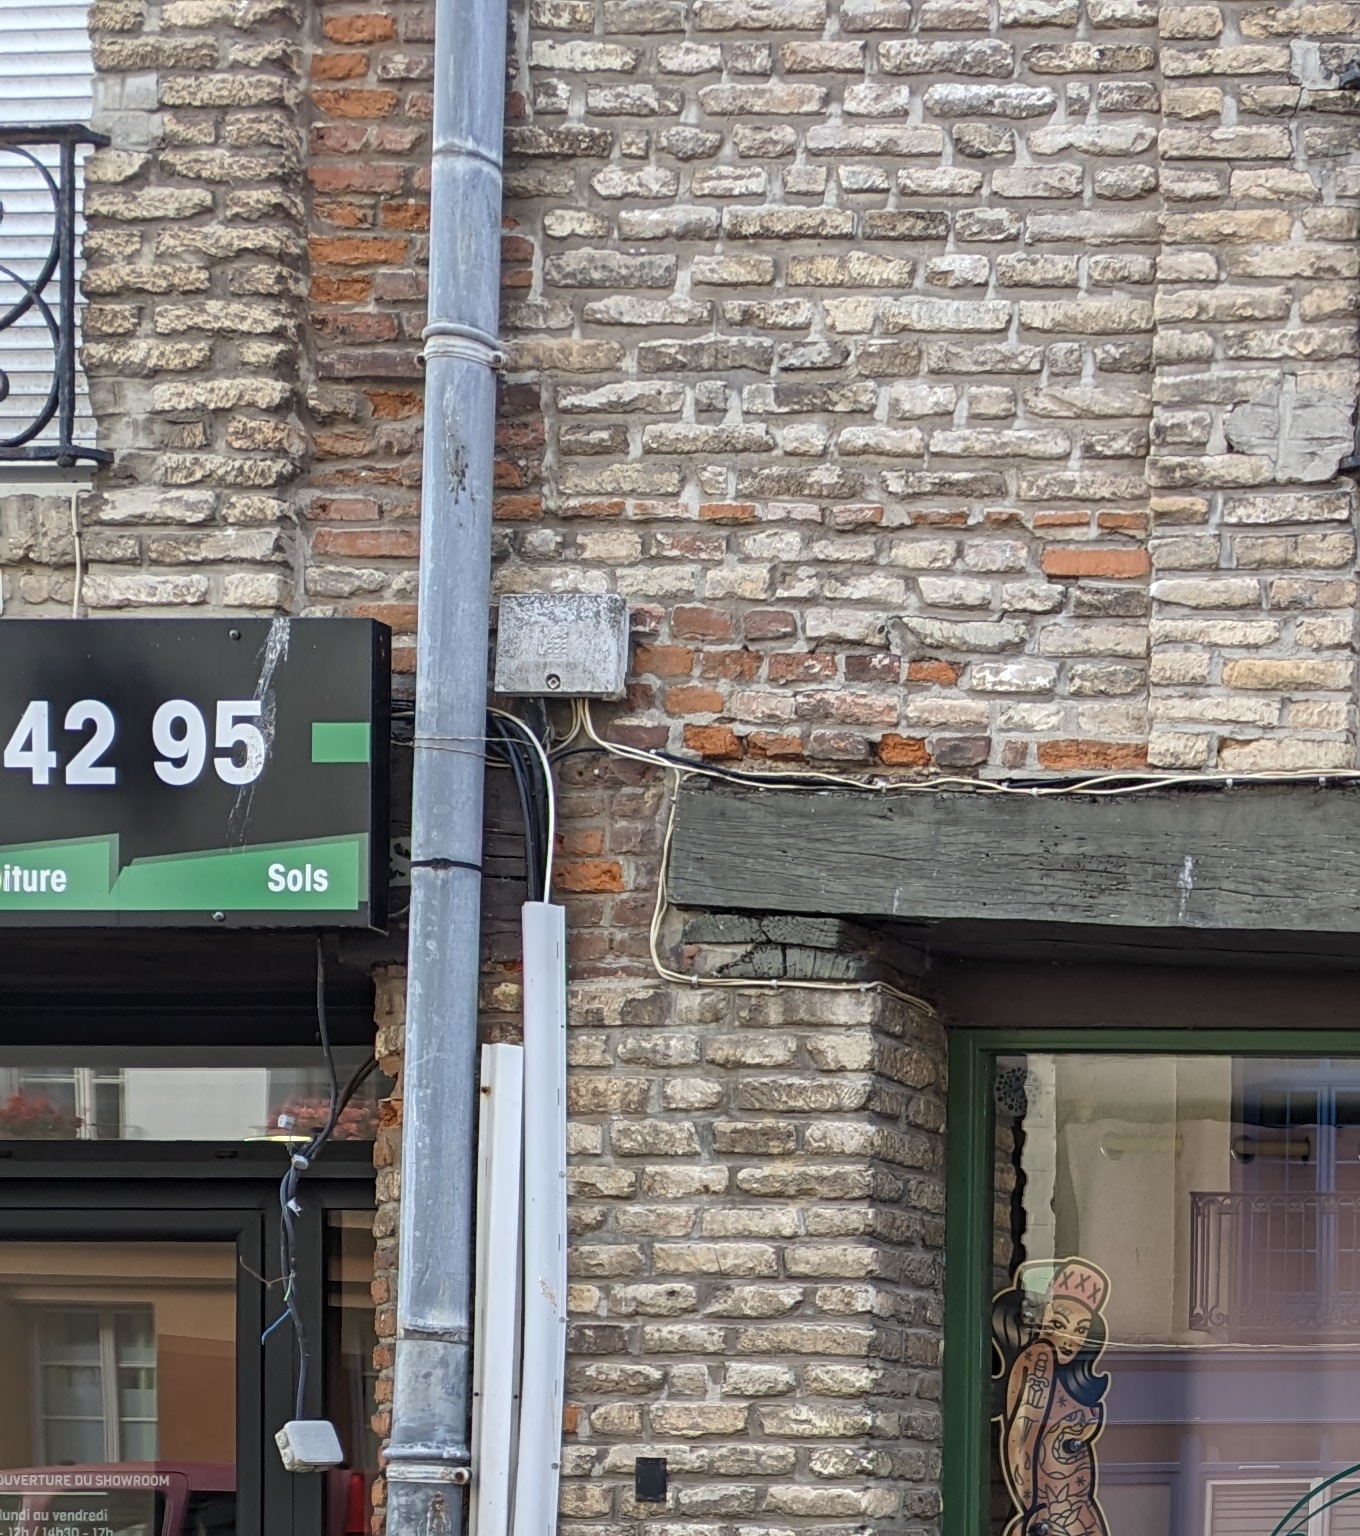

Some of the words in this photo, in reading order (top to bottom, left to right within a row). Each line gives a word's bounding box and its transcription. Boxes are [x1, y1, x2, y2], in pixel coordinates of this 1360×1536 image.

[3, 699, 116, 786] 42
[151, 699, 267, 787] 95
[0, 864, 67, 893] iture
[267, 863, 329, 893] Sols
[75, 1475, 92, 1486] DU
[95, 1475, 169, 1487] SHOWROOM
[33, 1511, 49, 1521] au
[52, 1509, 108, 1521] vendredi
